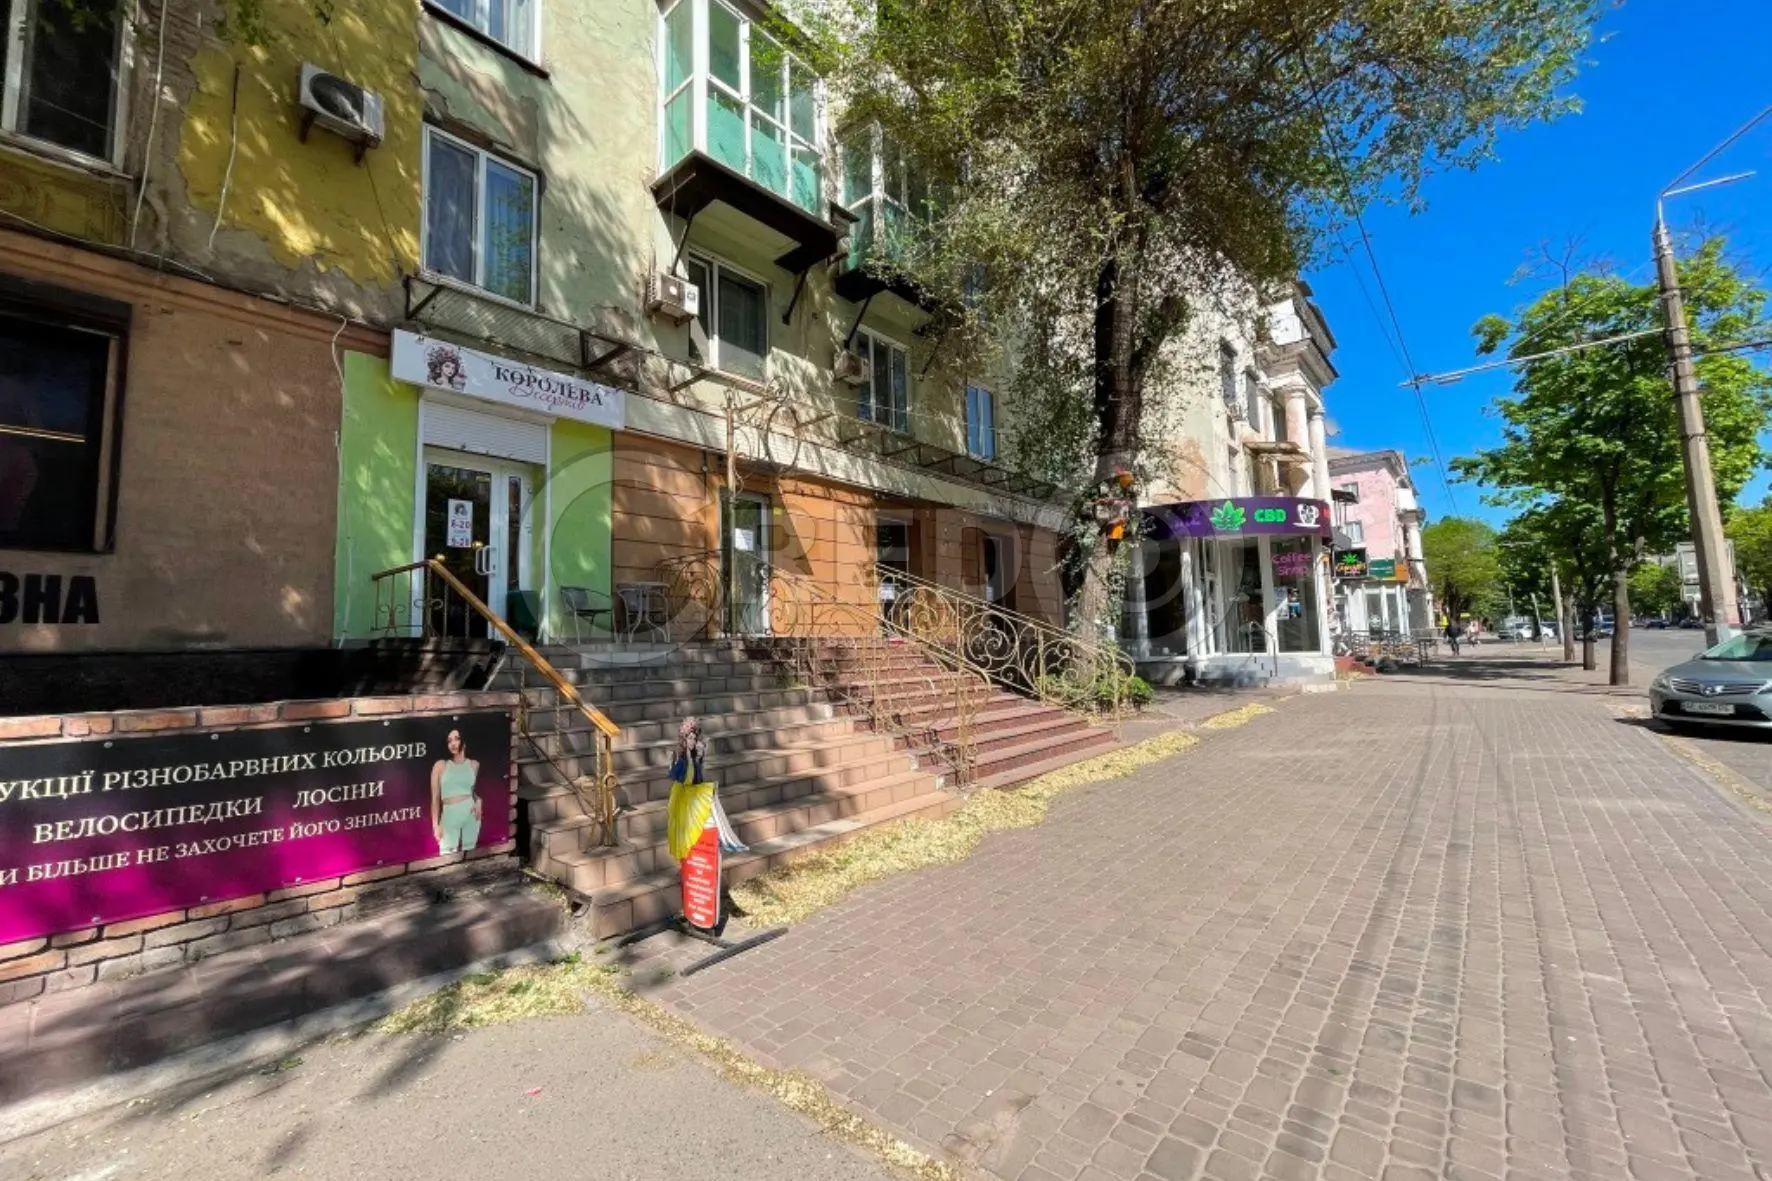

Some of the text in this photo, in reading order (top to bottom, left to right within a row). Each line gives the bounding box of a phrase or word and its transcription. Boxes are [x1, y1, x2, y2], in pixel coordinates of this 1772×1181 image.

[495, 366, 604, 406] КОРОЛЕВА
[1254, 507, 1288, 523] CBD
[0, 742, 427, 801] УКЦІЇ РІЗНОБАРВНИХ КОЛЬОРІВ
[32, 780, 385, 844] ВЕЛОСИПЕДКИ ЛОСІНИ
[26, 851, 131, 882] БІЛЬШЕ
[136, 845, 170, 865] НЕ
[174, 827, 284, 858] ЗАХОЧЕТЕ
[288, 819, 340, 841] ЙОГО
[344, 806, 421, 830] ЗНІМАТИ
